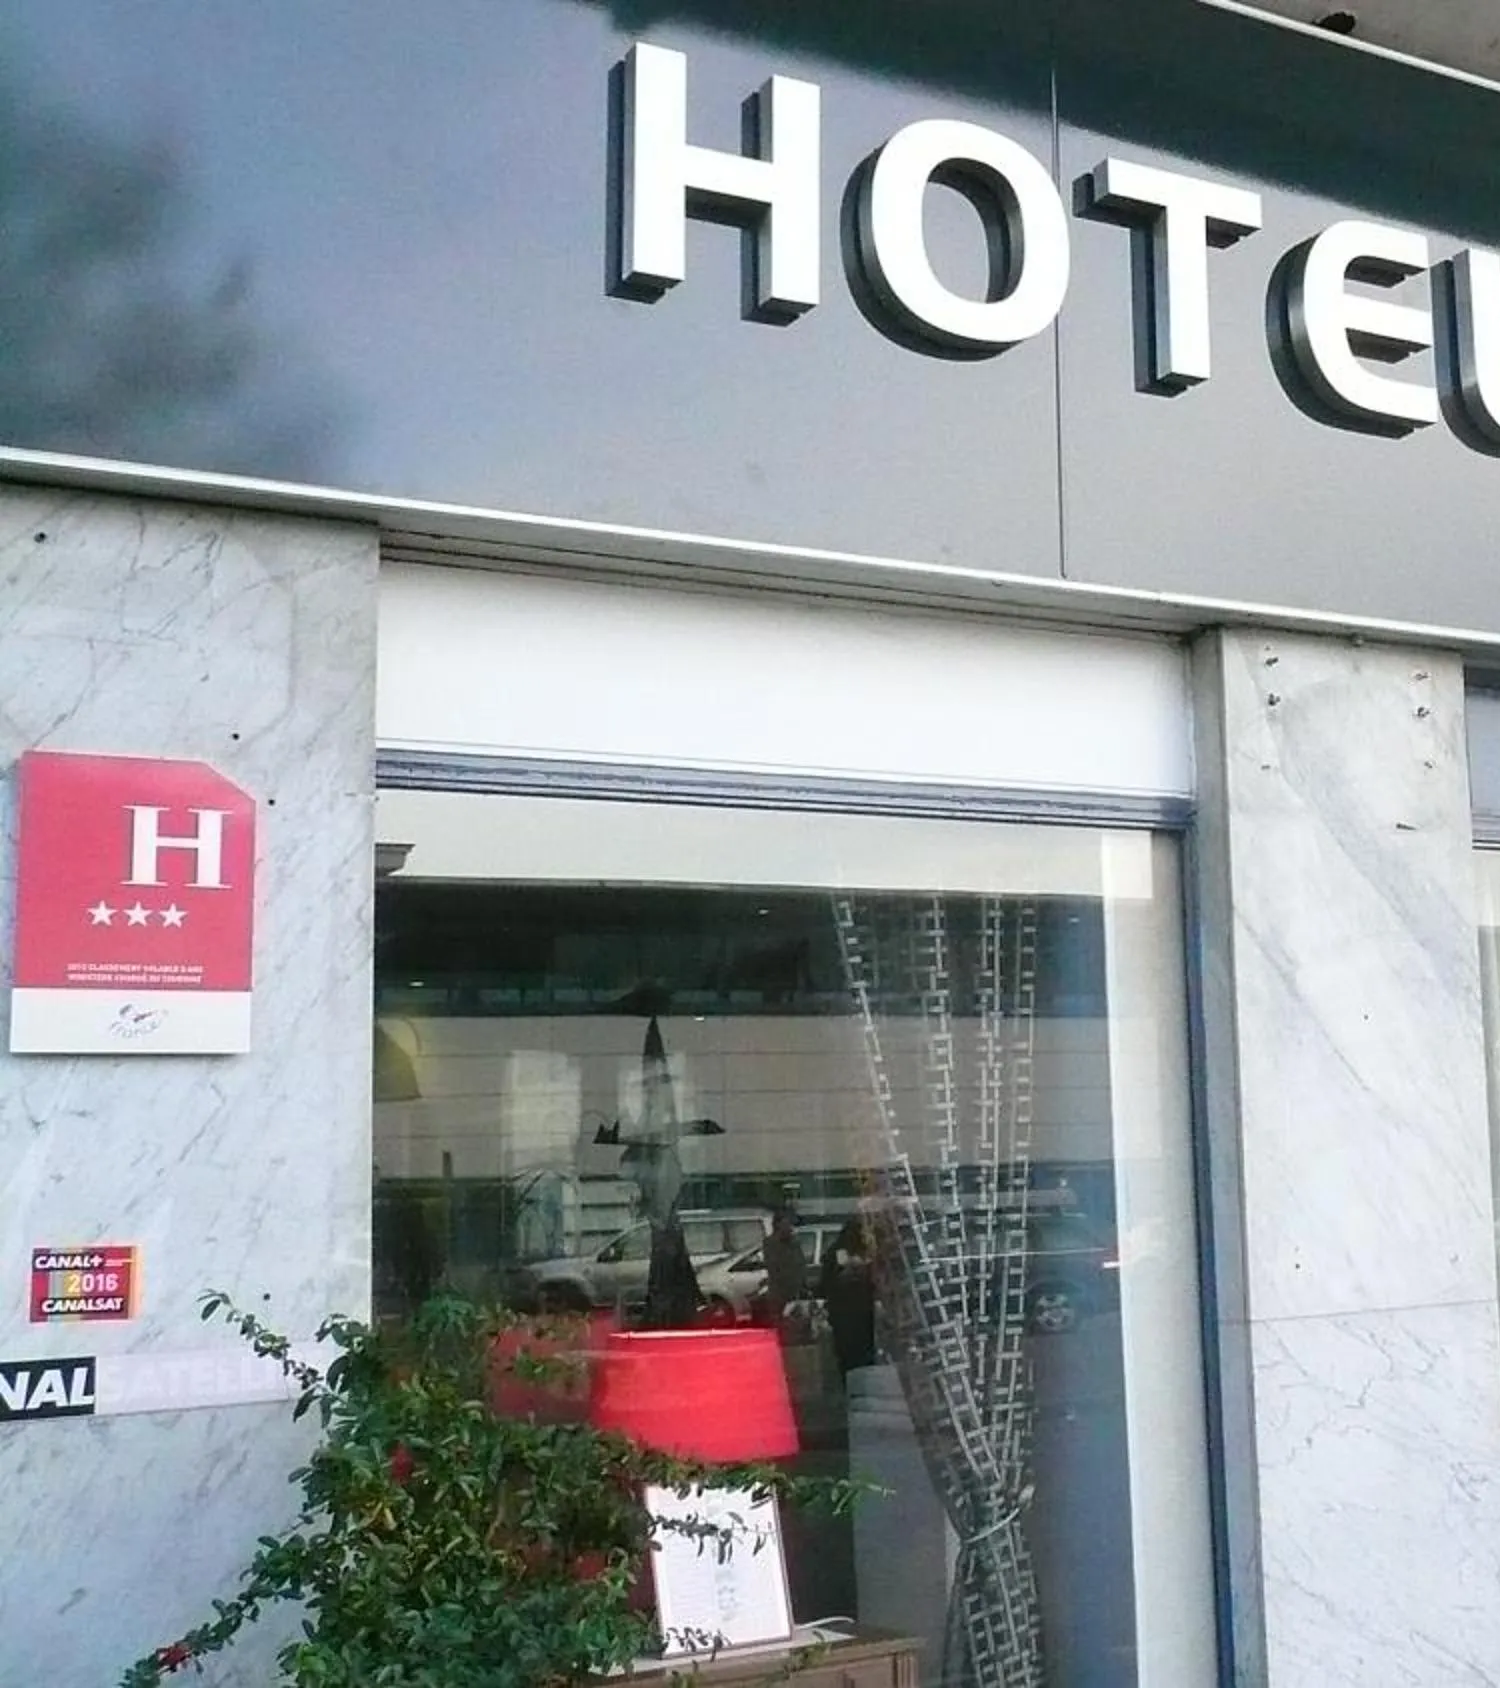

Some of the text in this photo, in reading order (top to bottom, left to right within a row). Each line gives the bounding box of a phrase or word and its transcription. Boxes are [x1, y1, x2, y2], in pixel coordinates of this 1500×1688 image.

[121, 803, 234, 889] H
[35, 1254, 103, 1269] CANAL+
[67, 1273, 119, 1293] 2016
[41, 1297, 125, 1313] CANALSAT
